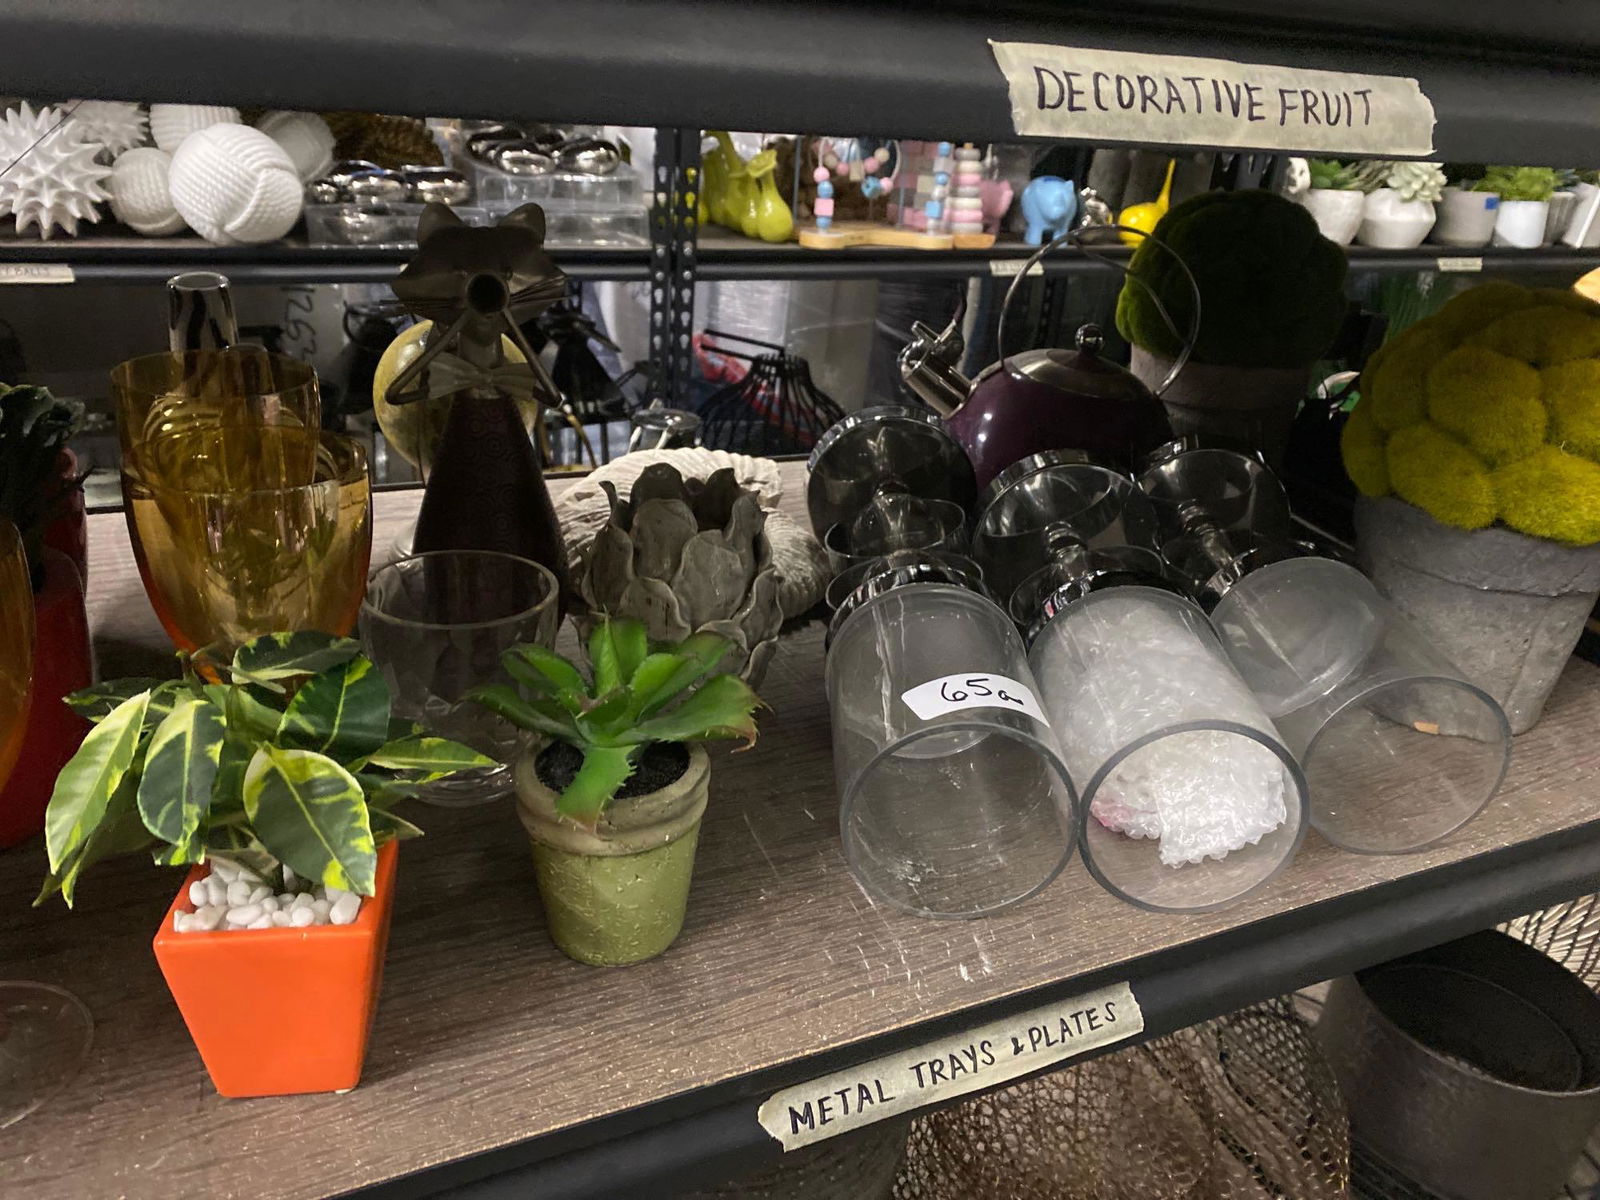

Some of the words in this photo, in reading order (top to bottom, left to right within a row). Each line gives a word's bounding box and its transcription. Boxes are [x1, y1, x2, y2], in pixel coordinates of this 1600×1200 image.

[1033, 65, 1266, 122] DECORATIVE
[1278, 88, 1373, 127] FRUIT
[787, 1079, 896, 1135] METAL
[908, 1040, 996, 1089] TRAYS
